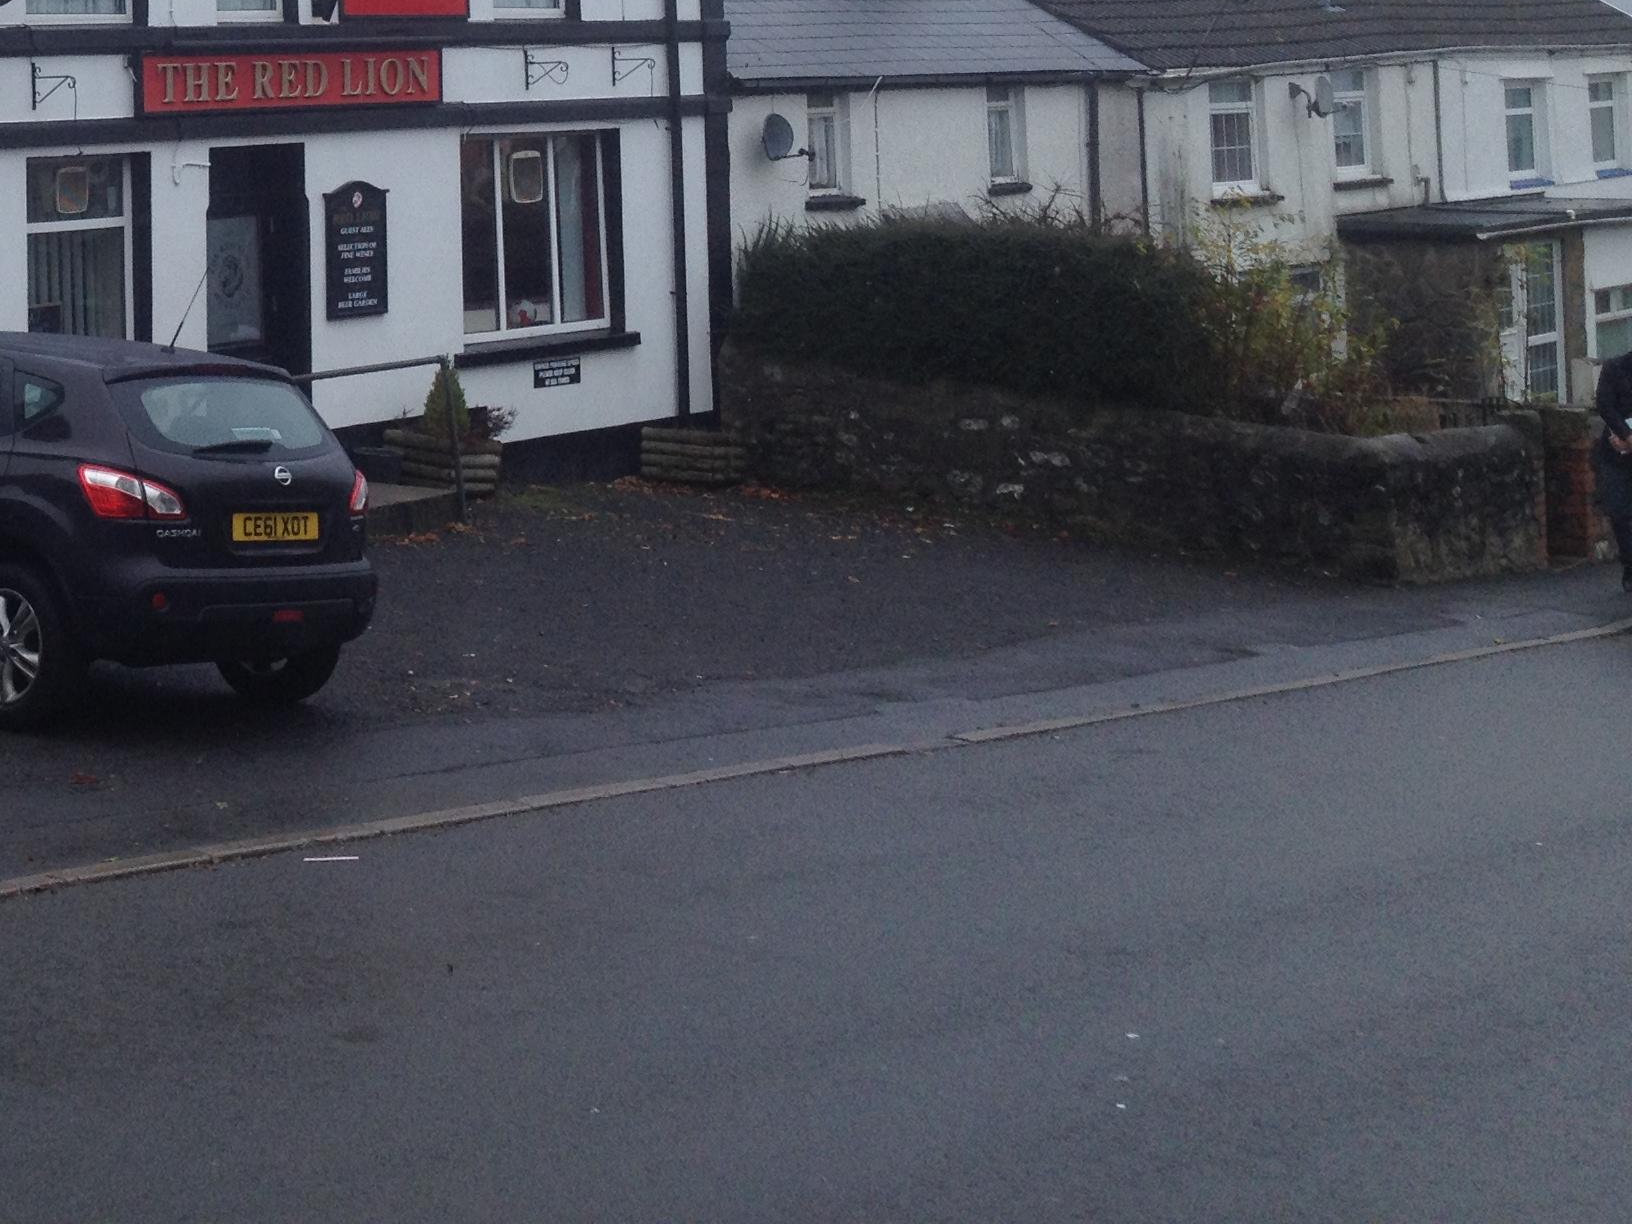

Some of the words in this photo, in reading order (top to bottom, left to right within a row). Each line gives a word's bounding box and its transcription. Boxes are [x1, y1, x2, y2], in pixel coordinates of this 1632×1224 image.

[157, 61, 239, 104] THE
[252, 58, 330, 101] RED
[340, 55, 430, 97] LION
[156, 529, 201, 539] QASHQAI
[243, 516, 278, 537] CE61
[281, 515, 310, 537] XOT
